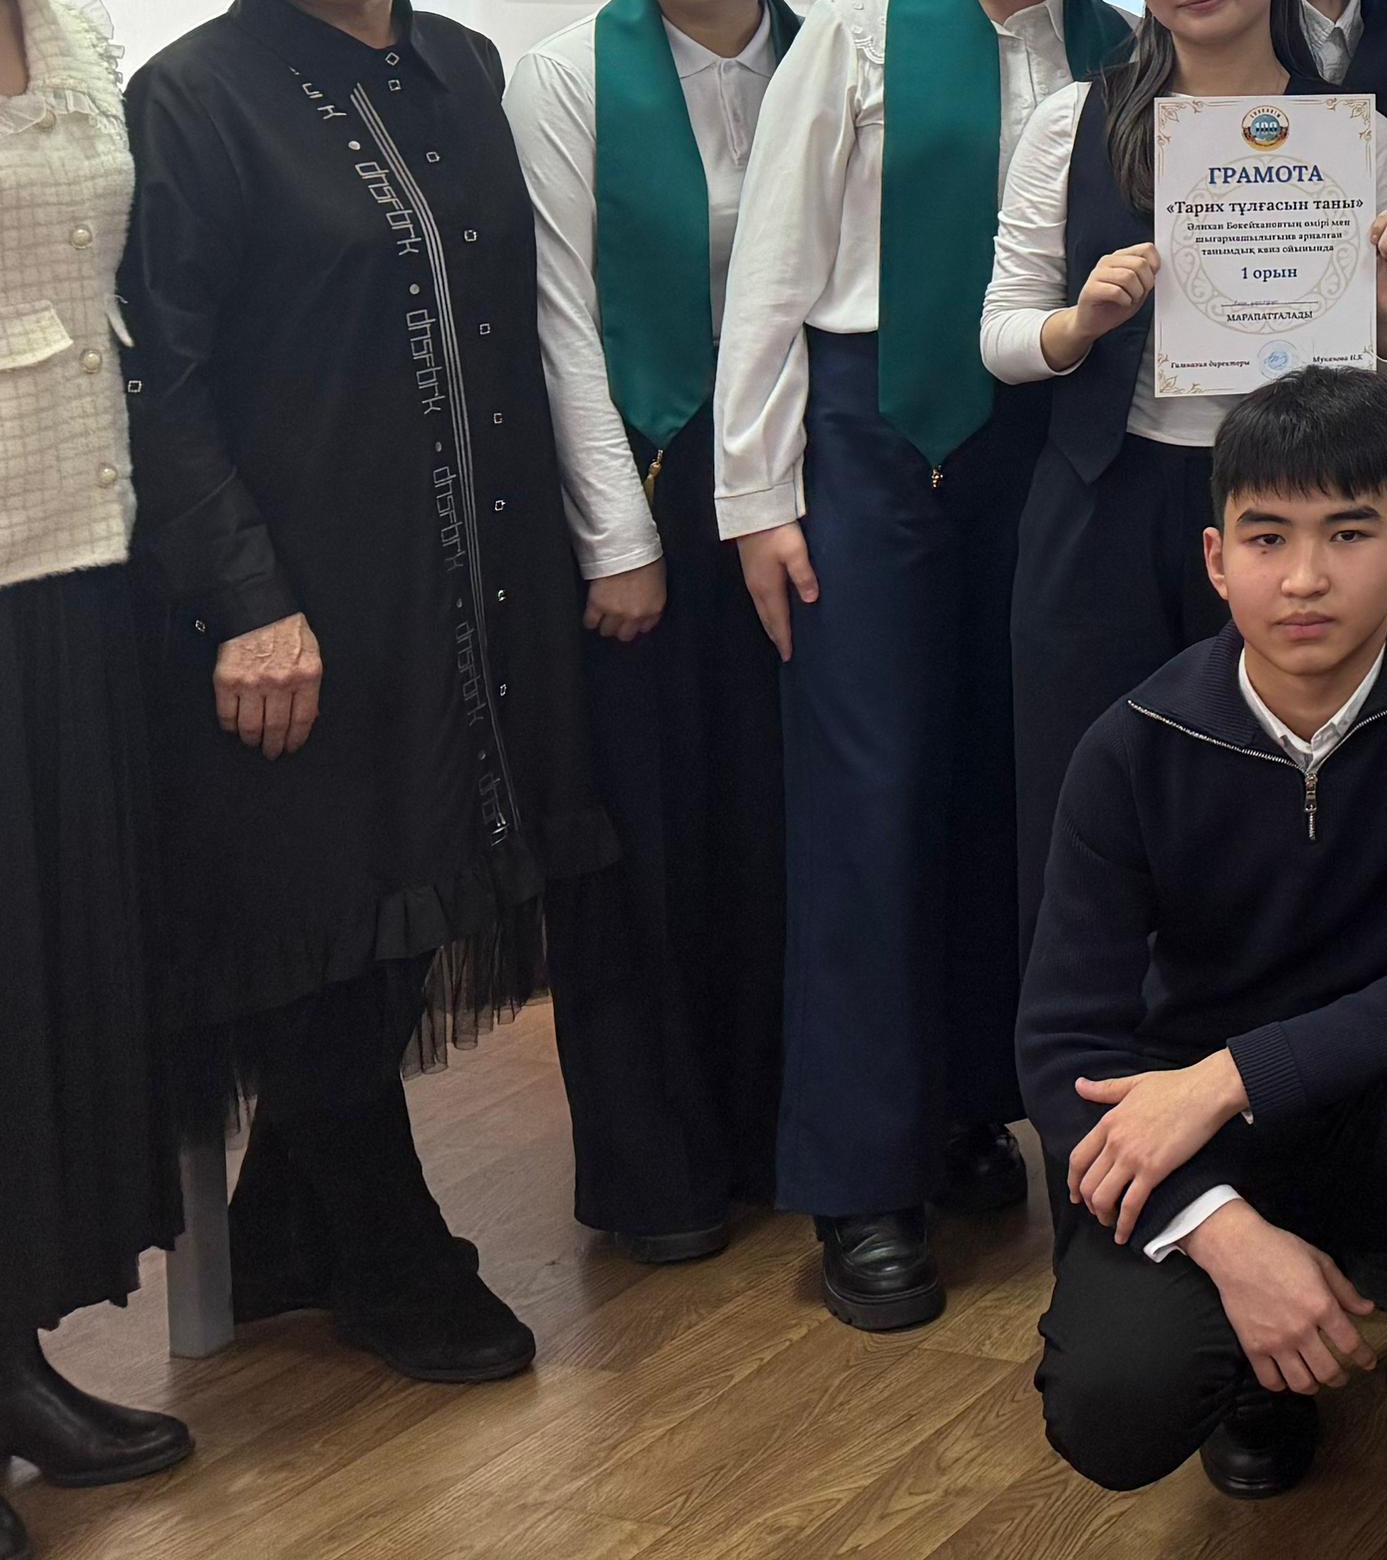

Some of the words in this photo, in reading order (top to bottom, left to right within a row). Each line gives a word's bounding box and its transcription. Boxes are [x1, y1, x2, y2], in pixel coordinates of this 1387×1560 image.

[1208, 165, 1324, 185] ГРАМОТА
[1166, 201, 1224, 217] «Тарих
[1229, 199, 1308, 216] тұлғасын
[1313, 198, 1364, 210] таны»
[1241, 267, 1248, 279] 1
[1253, 267, 1297, 282] орын
